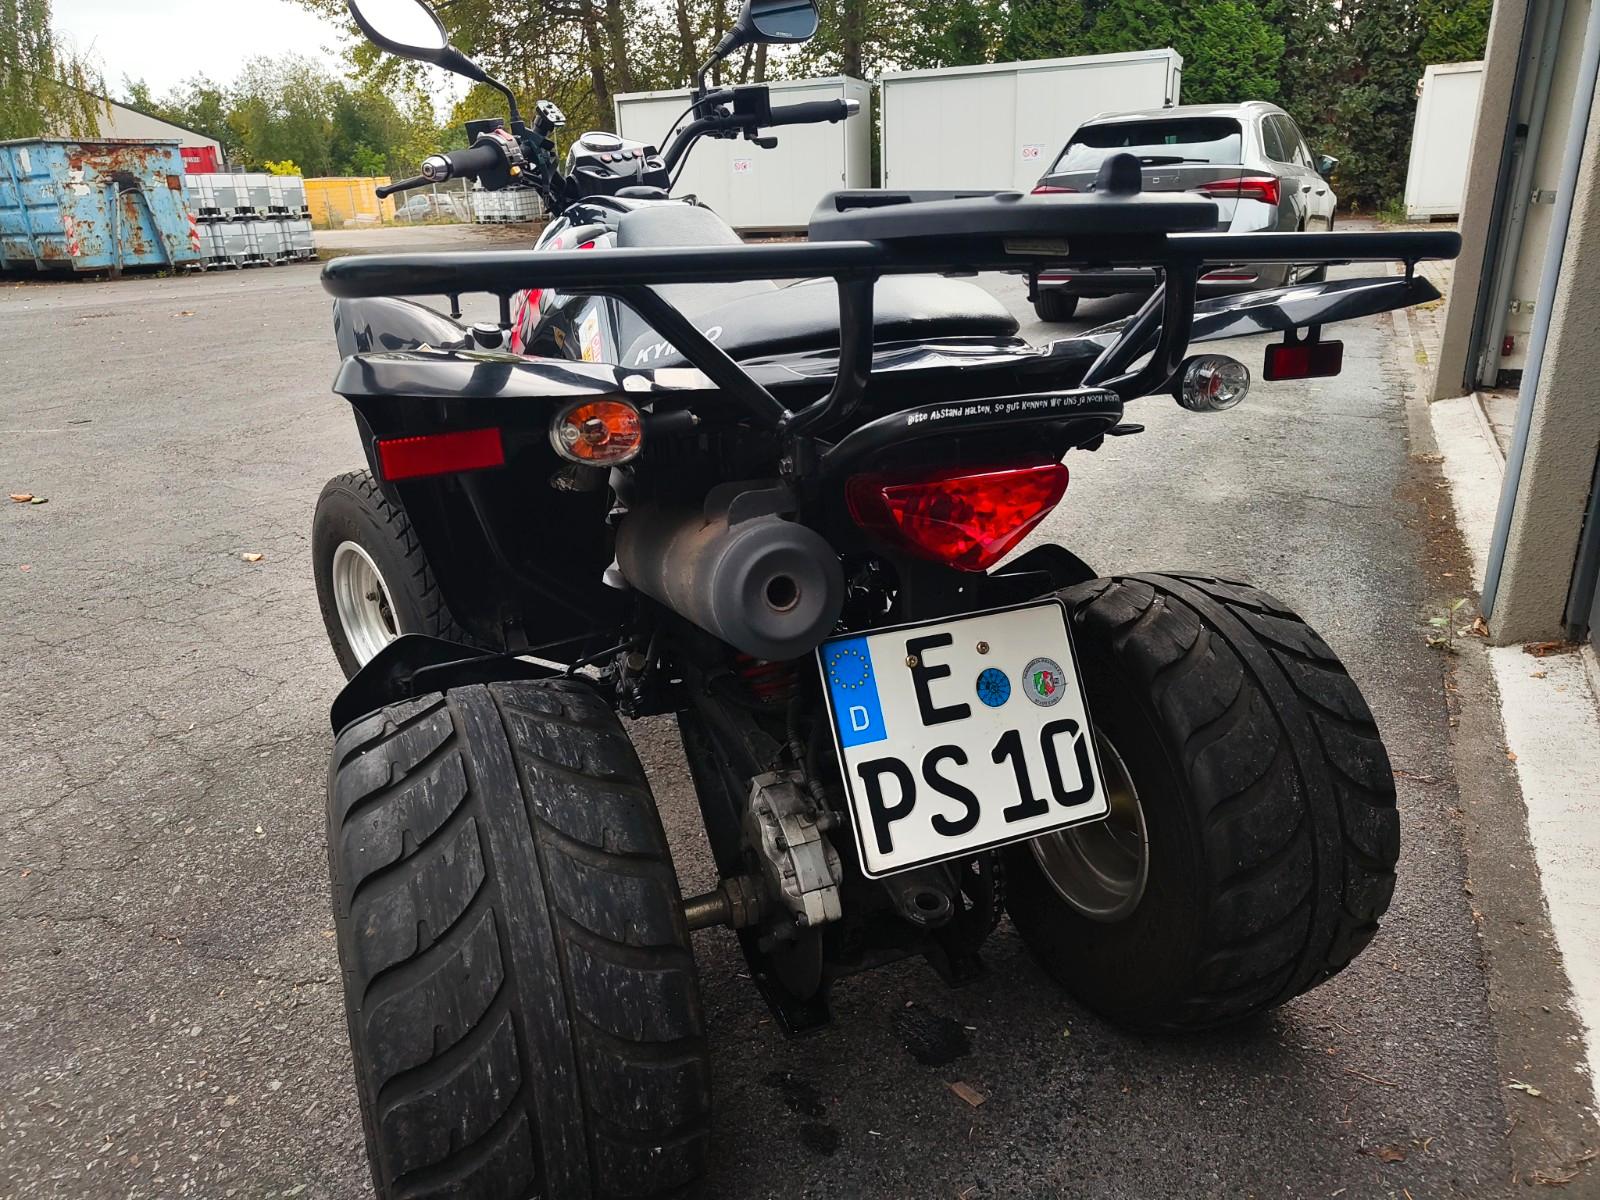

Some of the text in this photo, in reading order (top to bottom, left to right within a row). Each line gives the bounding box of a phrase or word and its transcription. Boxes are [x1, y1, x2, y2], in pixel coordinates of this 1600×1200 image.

[849, 705, 870, 732] D
[905, 632, 971, 726] E
[857, 718, 1095, 855] PS 10
